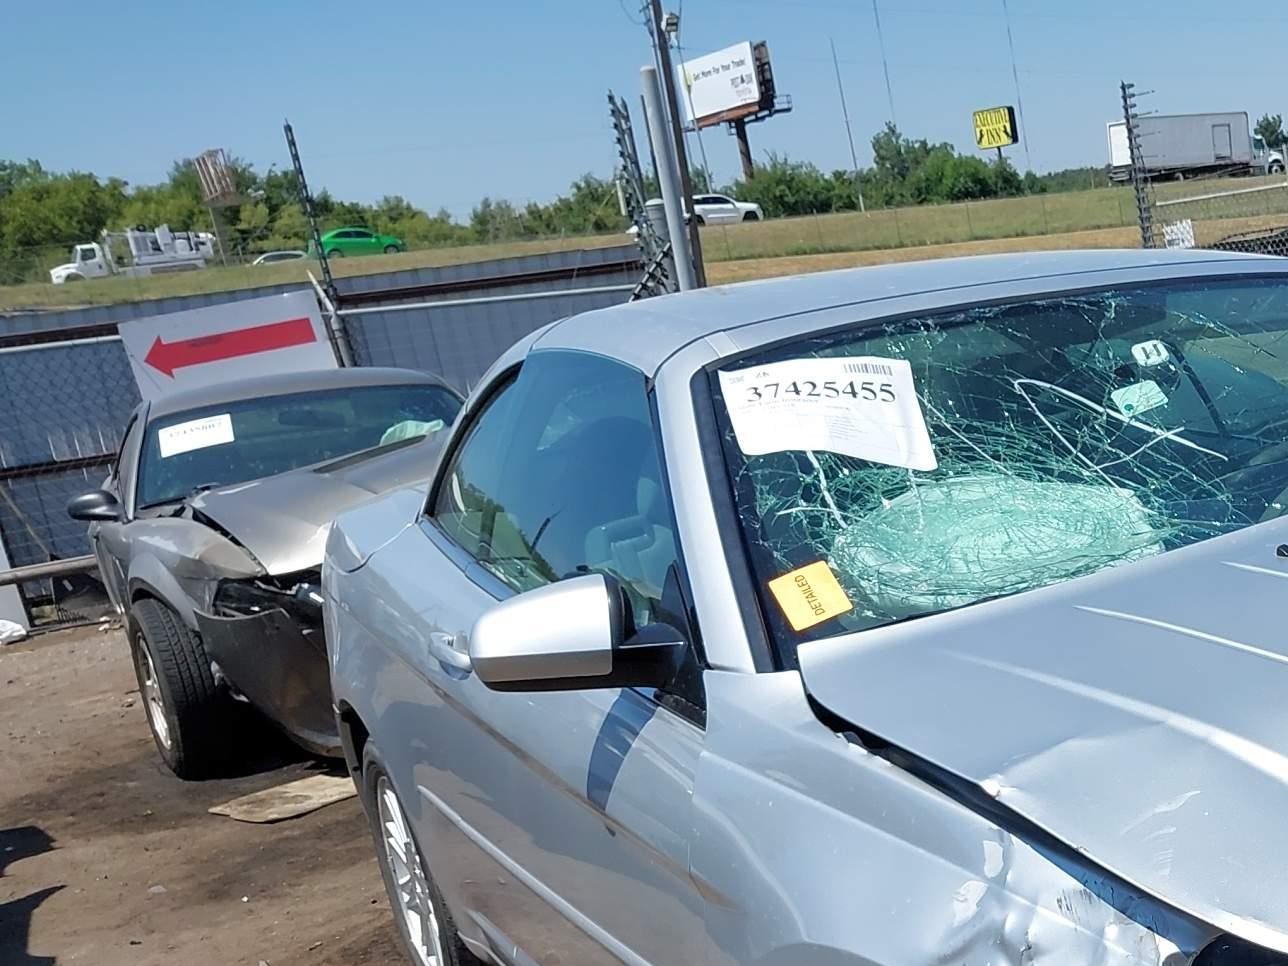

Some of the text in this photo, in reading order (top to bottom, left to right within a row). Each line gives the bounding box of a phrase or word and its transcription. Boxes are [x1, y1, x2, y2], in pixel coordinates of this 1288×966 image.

[986, 127, 1002, 145] INN
[746, 380, 896, 403] 37425455
[794, 574, 826, 616] DETAILED
